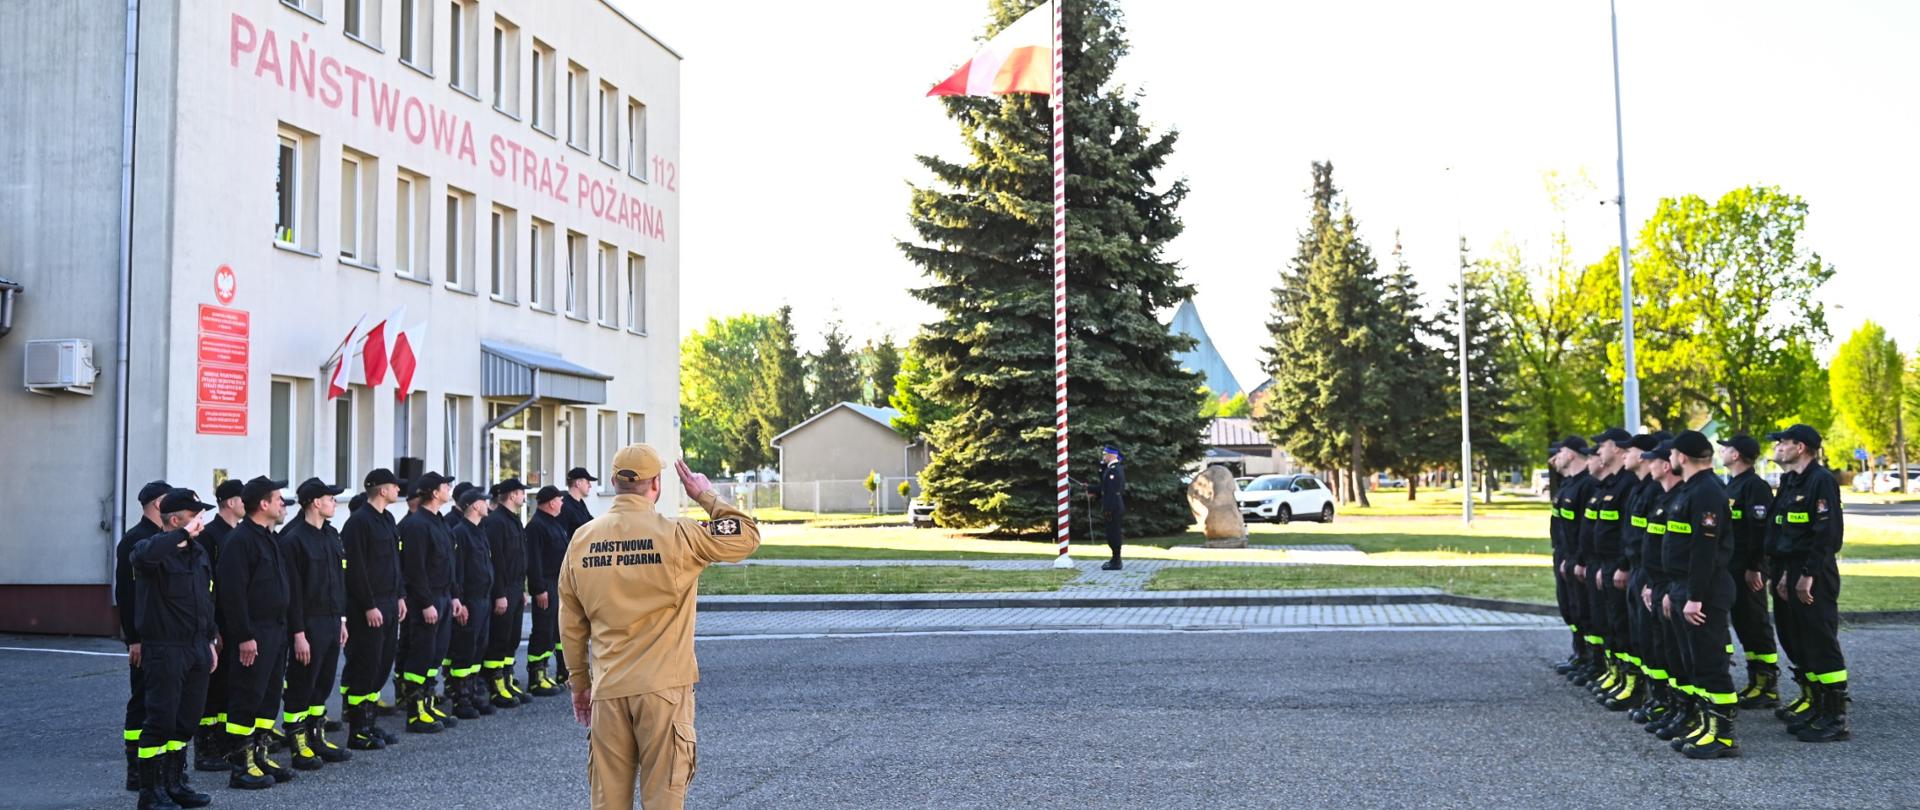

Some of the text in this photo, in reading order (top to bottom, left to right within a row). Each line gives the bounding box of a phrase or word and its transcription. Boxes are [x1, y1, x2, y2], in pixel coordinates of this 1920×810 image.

[230, 13, 665, 242] PAŃSTWOWA STRAŻ POŻARNA
[652, 155, 676, 192] 112
[589, 539, 654, 553] PAŃSTWOWA
[582, 552, 662, 568] STRAŻ POŻARNA
